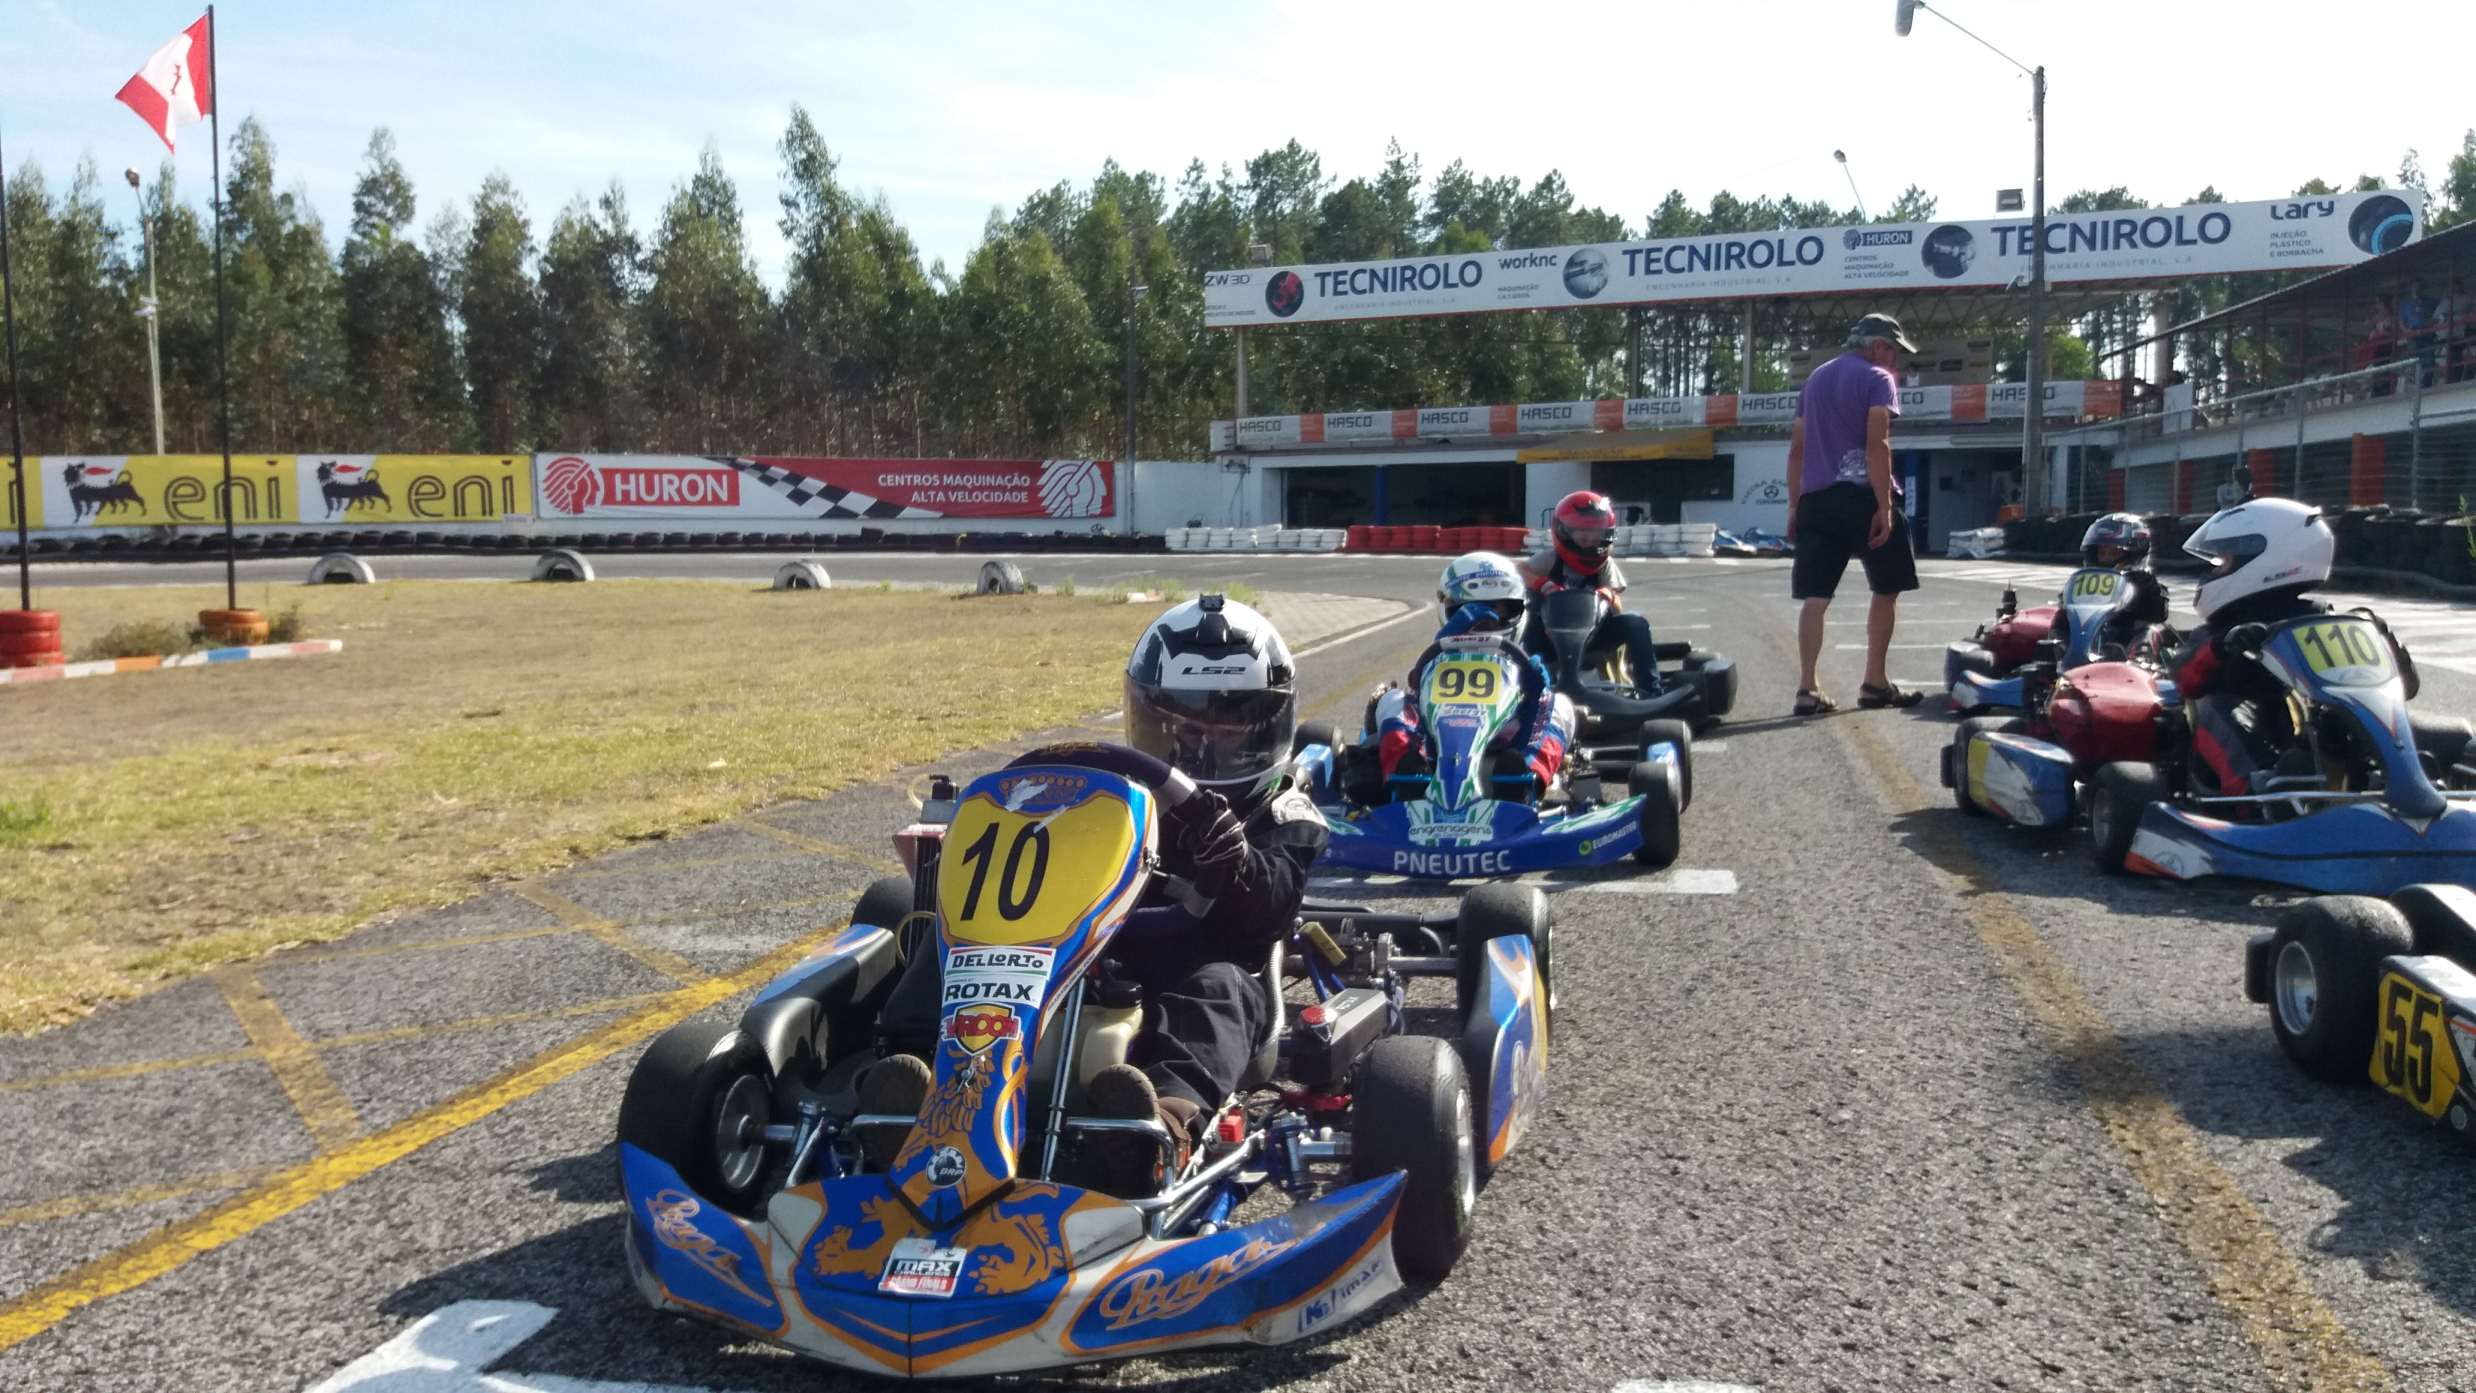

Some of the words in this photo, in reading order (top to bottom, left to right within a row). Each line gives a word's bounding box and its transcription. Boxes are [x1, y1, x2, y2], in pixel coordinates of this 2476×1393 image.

[1866, 231, 1909, 245] HURON
[1990, 212, 2231, 256] TECNIROLO
[1621, 235, 1825, 276] TECNIROLO
[1314, 260, 1483, 298] TECNIROLO
[1992, 386, 2056, 402] HASO
[1421, 411, 1469, 424] HASCO
[1520, 407, 1572, 420] HASCO
[1627, 402, 1681, 415] HASCO
[1239, 420, 1282, 433] HASCO
[1327, 416, 1373, 429] HASCO
[164, 459, 283, 520] eni
[407, 459, 516, 518] eni
[614, 473, 729, 502] HURON
[878, 474, 940, 487] CENTROS
[943, 472, 1031, 489] MAQUINAÇÃO
[911, 491, 946, 503] ALTA
[948, 490, 1029, 503] VELOCIDADE
[2073, 574, 2115, 596] 109
[2304, 623, 2381, 668] 110
[1182, 666, 1246, 675] LS2
[1438, 667, 1496, 698] 99
[959, 820, 1050, 922] 10
[1393, 850, 1511, 875] PNEUTEC
[944, 982, 1035, 1001] ROTAX
[2382, 980, 2440, 1104] 55
